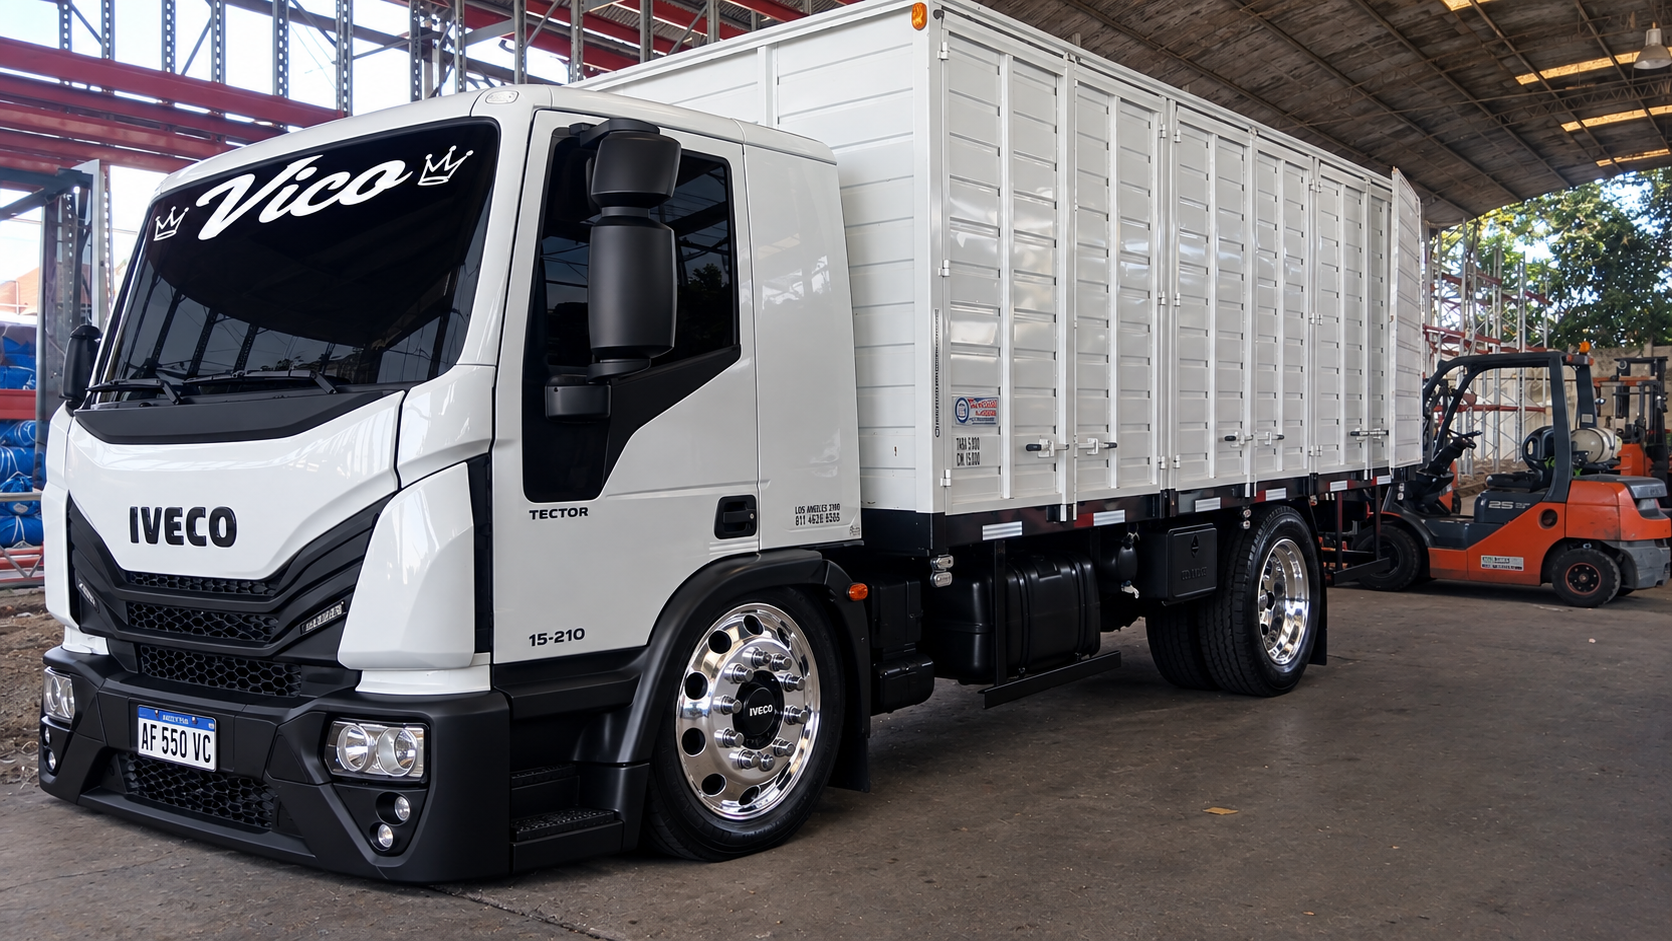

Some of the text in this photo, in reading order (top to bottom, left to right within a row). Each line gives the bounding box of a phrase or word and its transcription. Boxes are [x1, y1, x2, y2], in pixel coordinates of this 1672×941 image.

[196, 155, 413, 240] Vico
[795, 506, 805, 514] LOS
[1488, 501, 1514, 509] 25
[529, 507, 588, 520] TECTOR
[129, 506, 238, 548] IVECO
[529, 627, 586, 647] 15-210
[749, 704, 773, 717] IVECO
[141, 722, 212, 764] AF 550 VC
